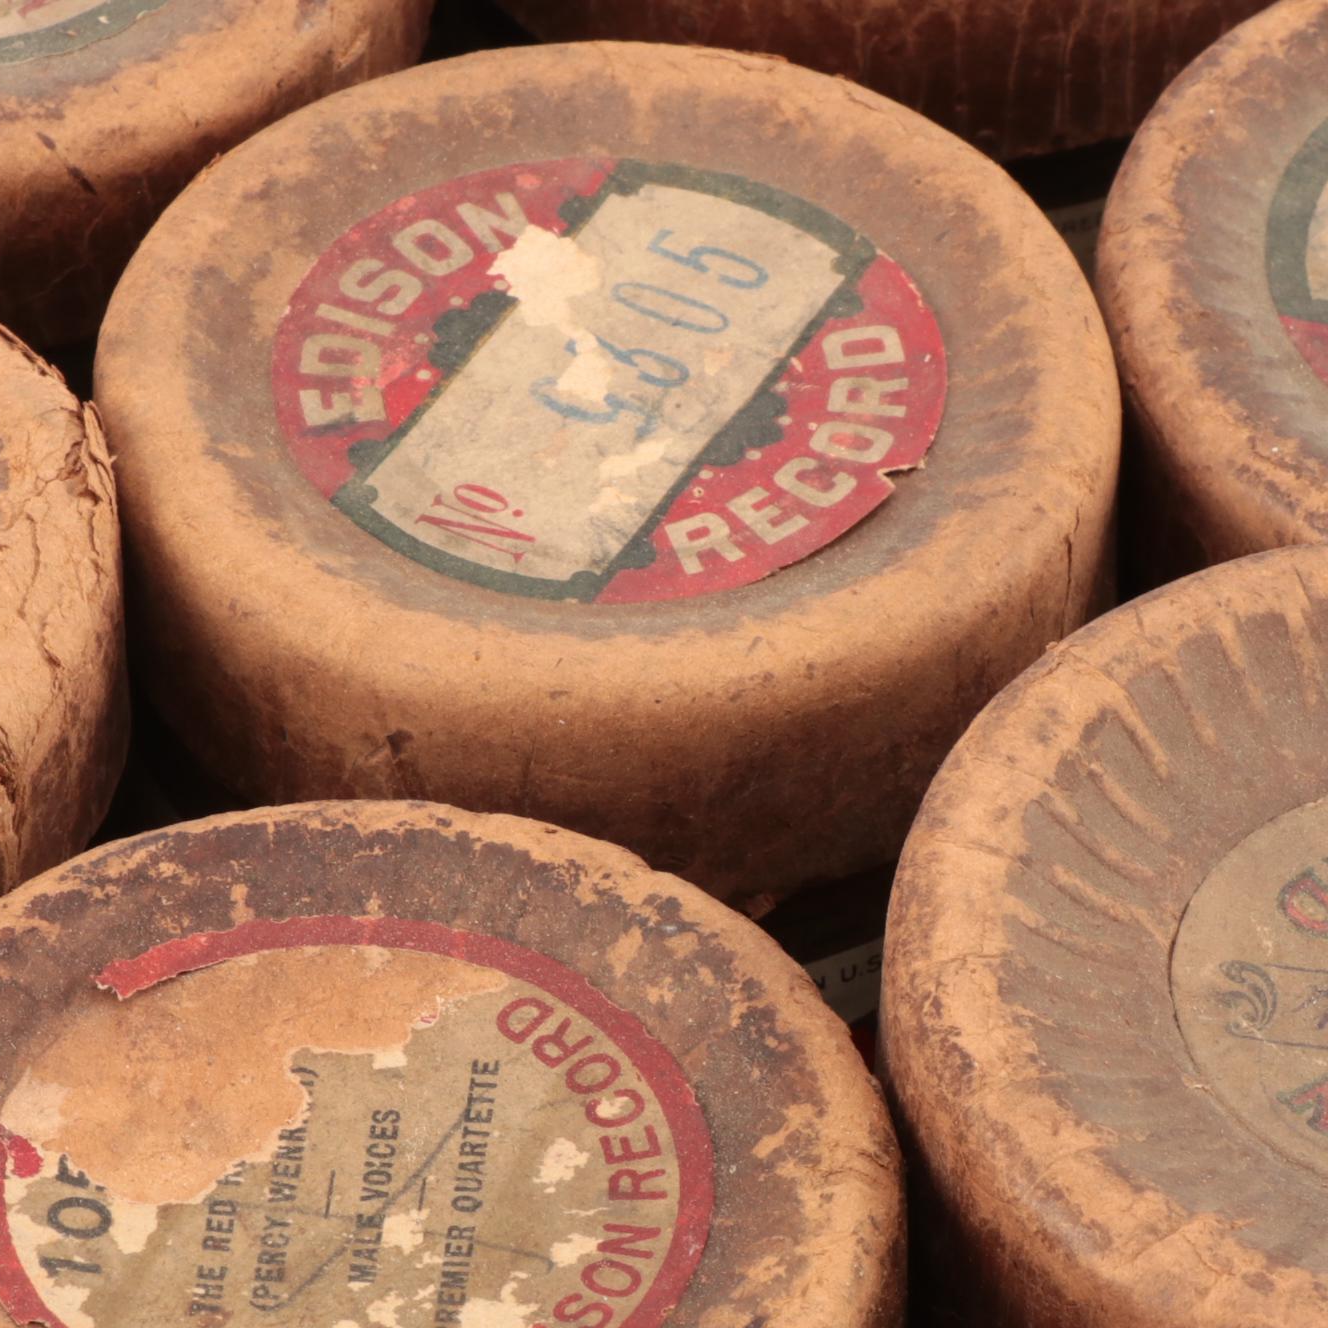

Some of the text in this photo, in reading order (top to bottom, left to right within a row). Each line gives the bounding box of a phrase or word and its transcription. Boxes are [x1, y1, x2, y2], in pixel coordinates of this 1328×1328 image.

[299, 192, 531, 430] EDISON
[663, 325, 909, 576] RECORD
[452, 1059, 500, 1214] QUARTETTE
[496, 996, 669, 1203] RECORD
[202, 1199, 238, 1253] RED
[347, 1108, 401, 1284] MALE VOICES
